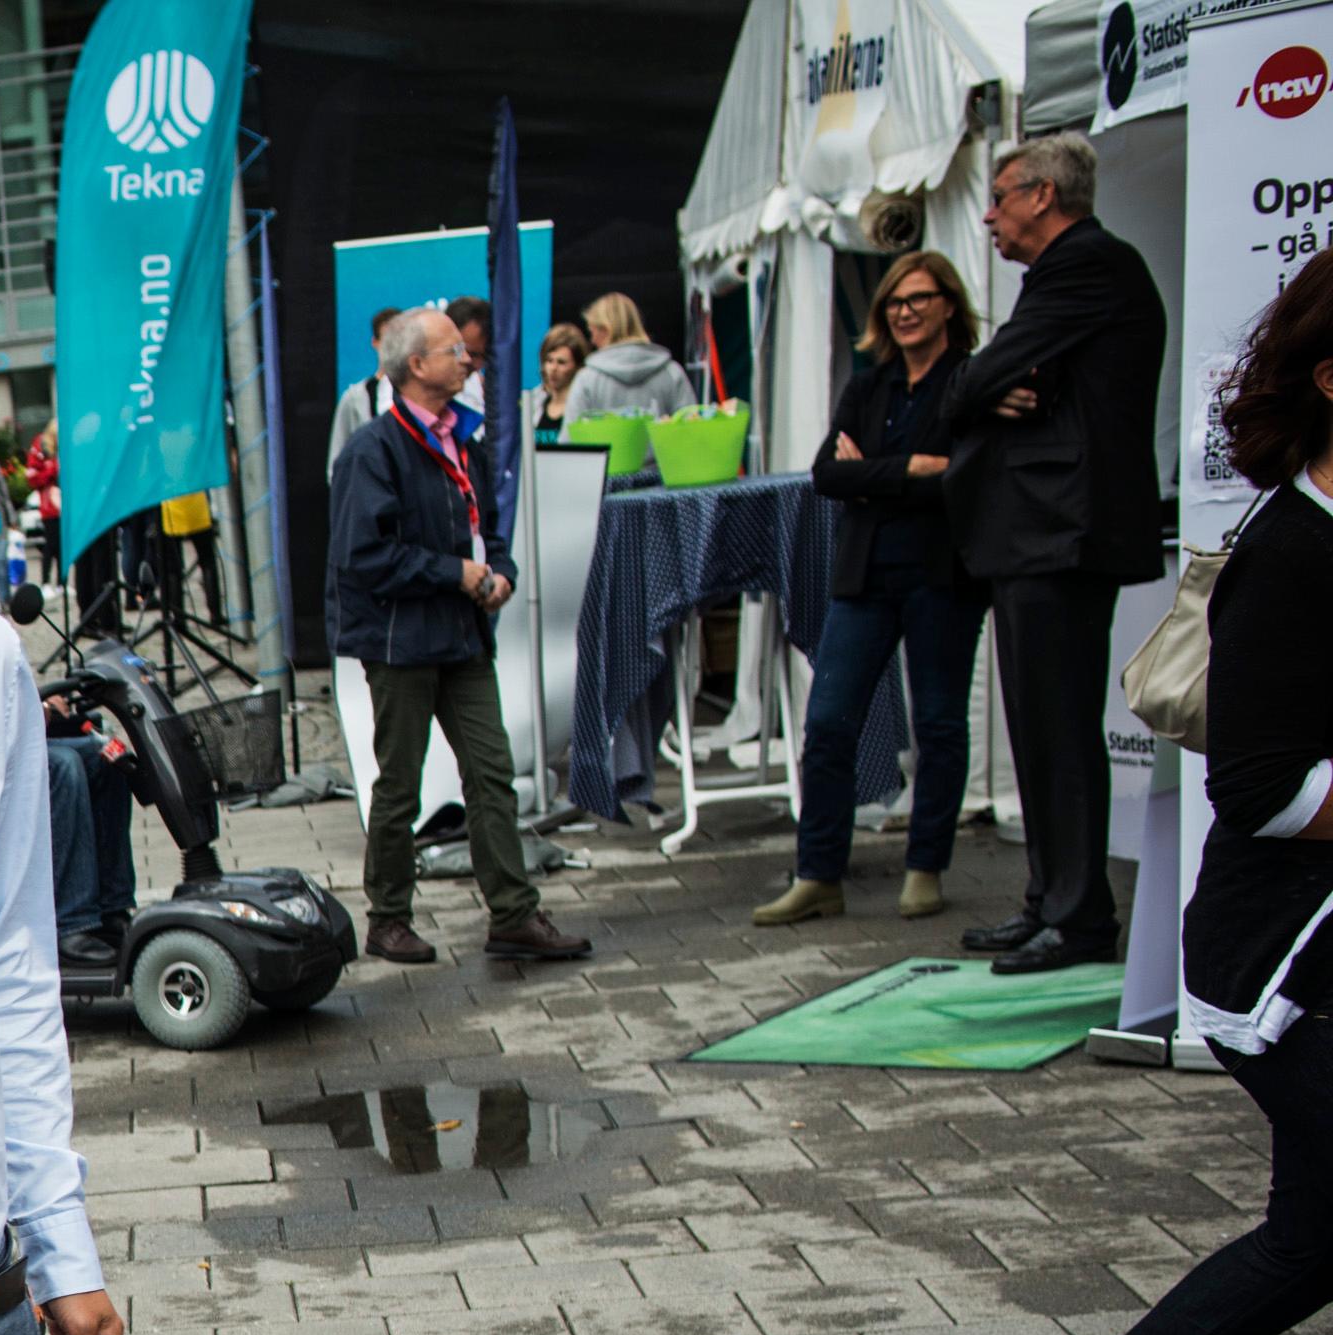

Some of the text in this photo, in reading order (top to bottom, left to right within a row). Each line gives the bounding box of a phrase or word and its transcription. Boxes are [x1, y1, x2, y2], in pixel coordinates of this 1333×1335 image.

[1259, 73, 1324, 104] nav
[104, 162, 206, 202] Tekna
[1277, 221, 1317, 263] gå
